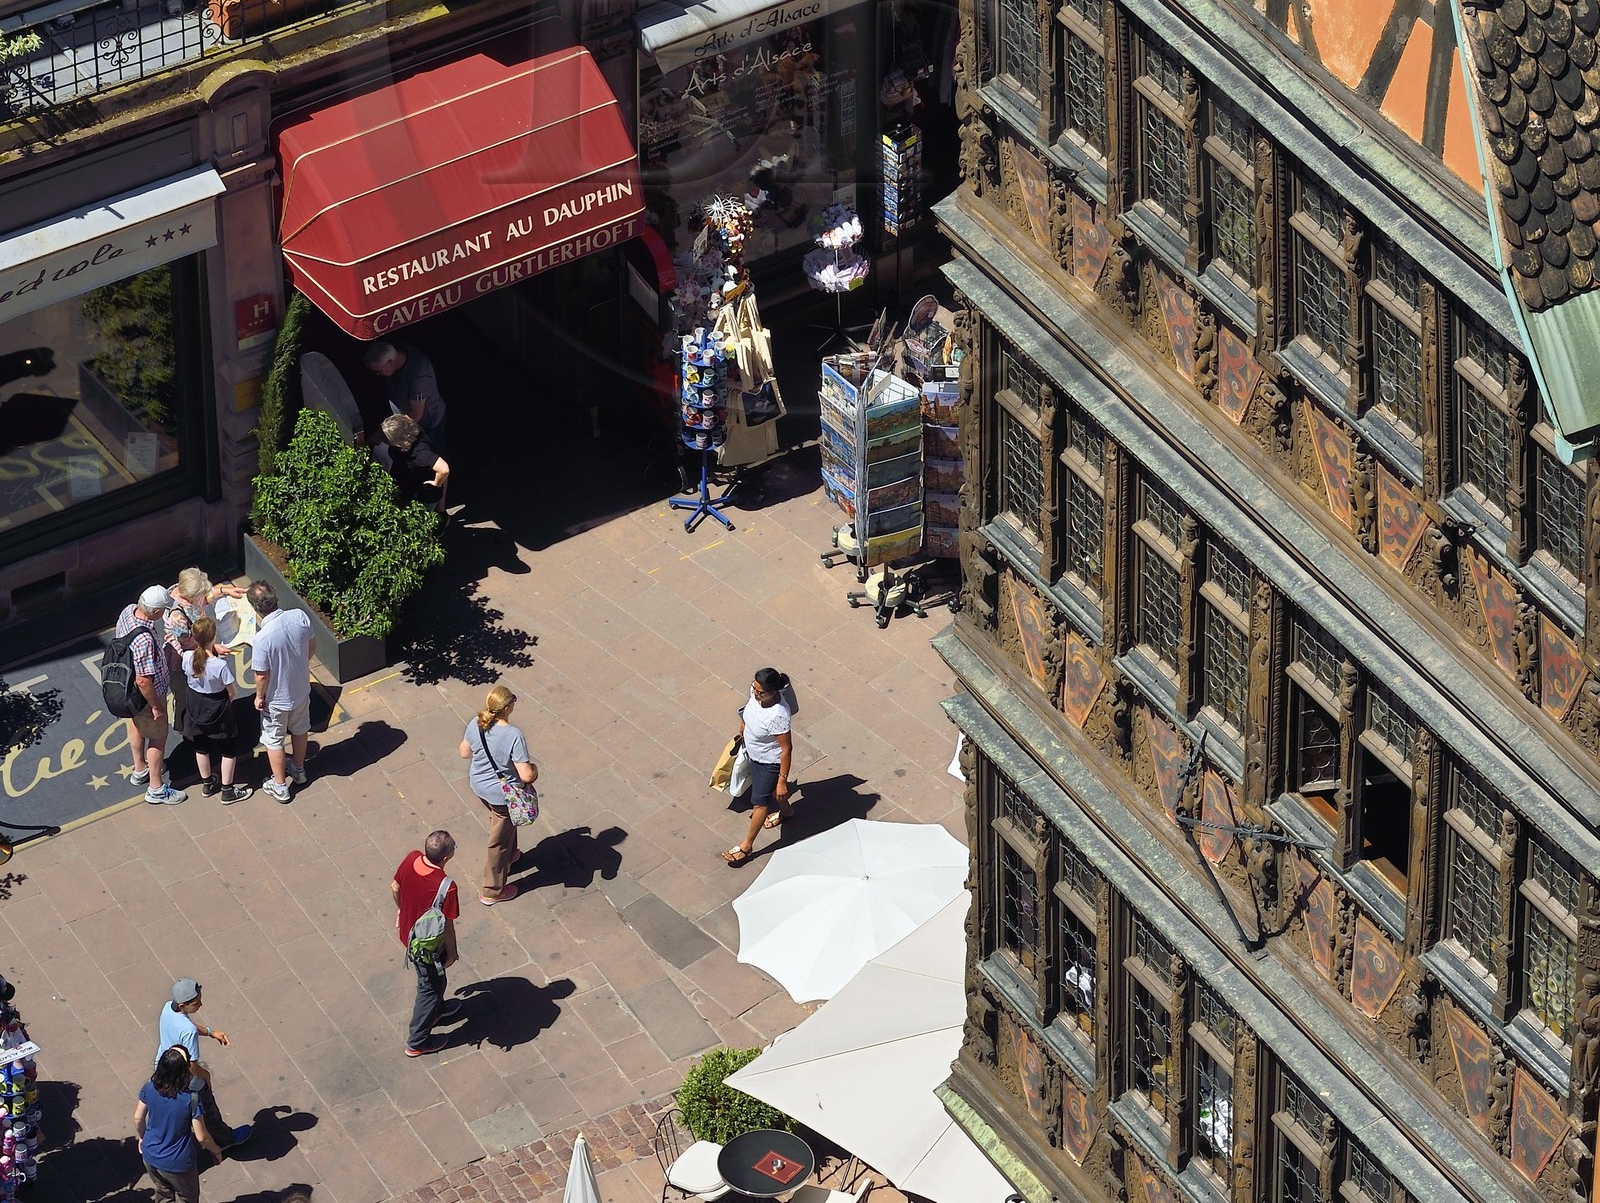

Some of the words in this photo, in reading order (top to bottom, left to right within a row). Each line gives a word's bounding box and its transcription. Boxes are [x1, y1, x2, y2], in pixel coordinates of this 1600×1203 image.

[694, 33, 735, 57] Arts
[740, 2, 821, 39] d'Alsace
[681, 69, 727, 99] Arts
[733, 42, 813, 77] d'Alsace
[362, 231, 493, 296] RESTAURANT
[506, 216, 533, 242] AU
[543, 179, 633, 227] DAUPHIN
[373, 284, 463, 334] CAVEAU
[475, 219, 638, 294] GURTLERHOFT
[253, 300, 270, 319] H
